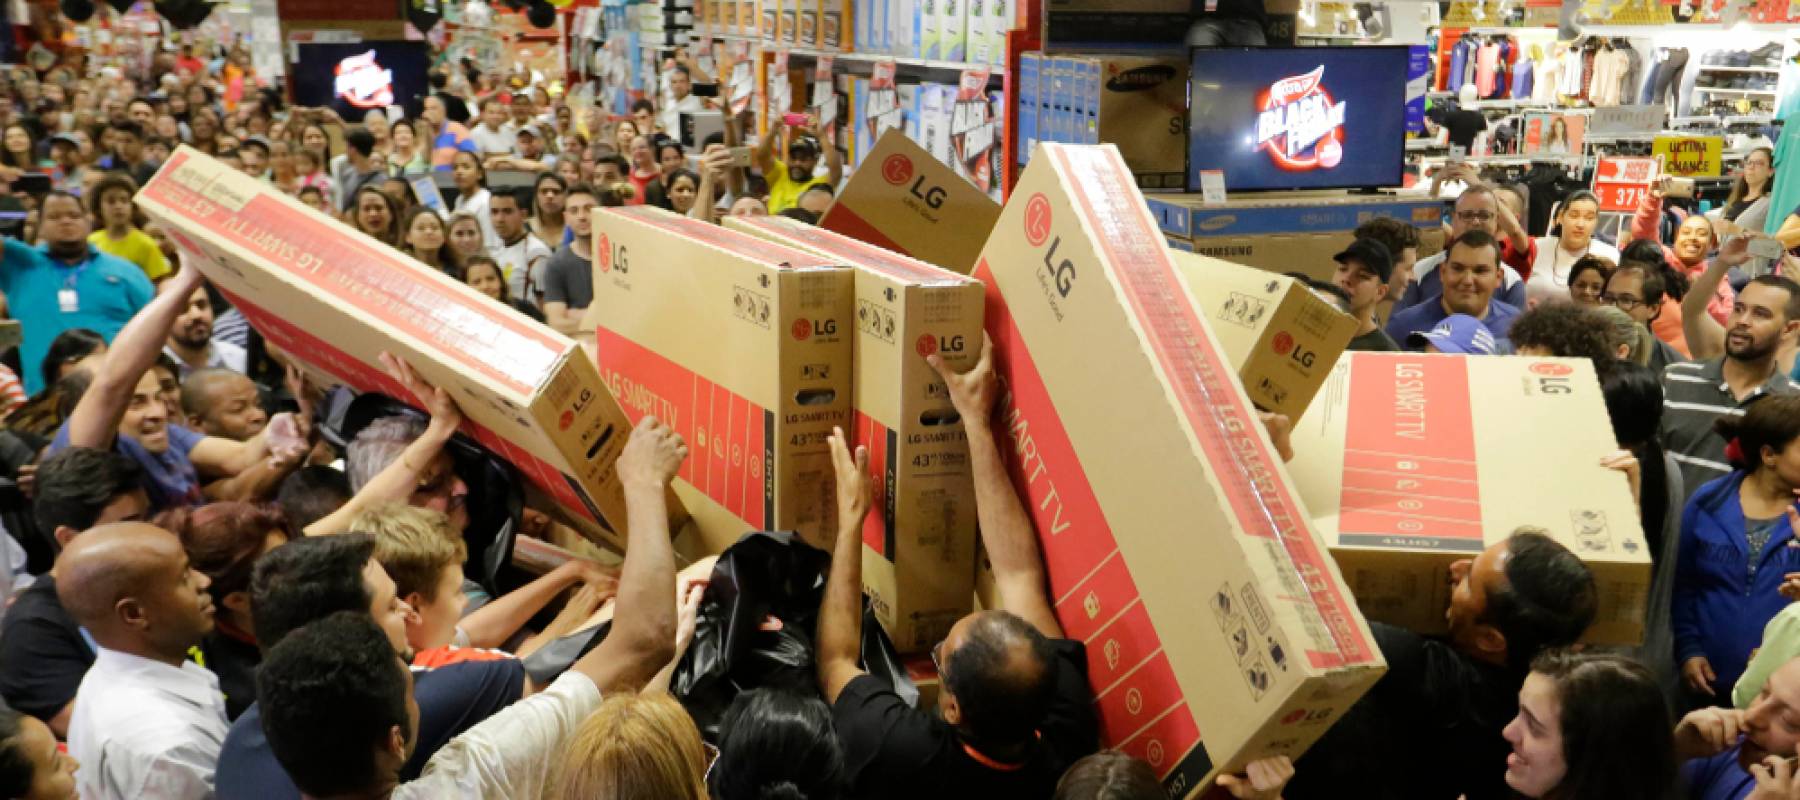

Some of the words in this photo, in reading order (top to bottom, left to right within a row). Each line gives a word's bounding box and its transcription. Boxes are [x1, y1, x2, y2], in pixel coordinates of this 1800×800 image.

[910, 175, 948, 210] LG
[222, 214, 251, 240] TV
[612, 242, 629, 274] LG
[1198, 245, 1253, 258] SAMSUNG
[298, 254, 324, 275] LG
[1043, 236, 1076, 298] LG
[814, 319, 837, 336] LG
[940, 335, 964, 352] LG
[1292, 344, 1316, 368] LG
[1396, 363, 1424, 378] LG
[605, 368, 622, 400] LG
[1540, 377, 1572, 394] LG
[573, 388, 591, 412] LG
[1395, 379, 1426, 419] SMART
[785, 414, 798, 425] LG
[1217, 403, 1246, 433] LG
[1395, 418, 1427, 441] TV
[908, 433, 922, 445] LG
[1040, 479, 1072, 537] TV
[1306, 706, 1334, 722] LG
